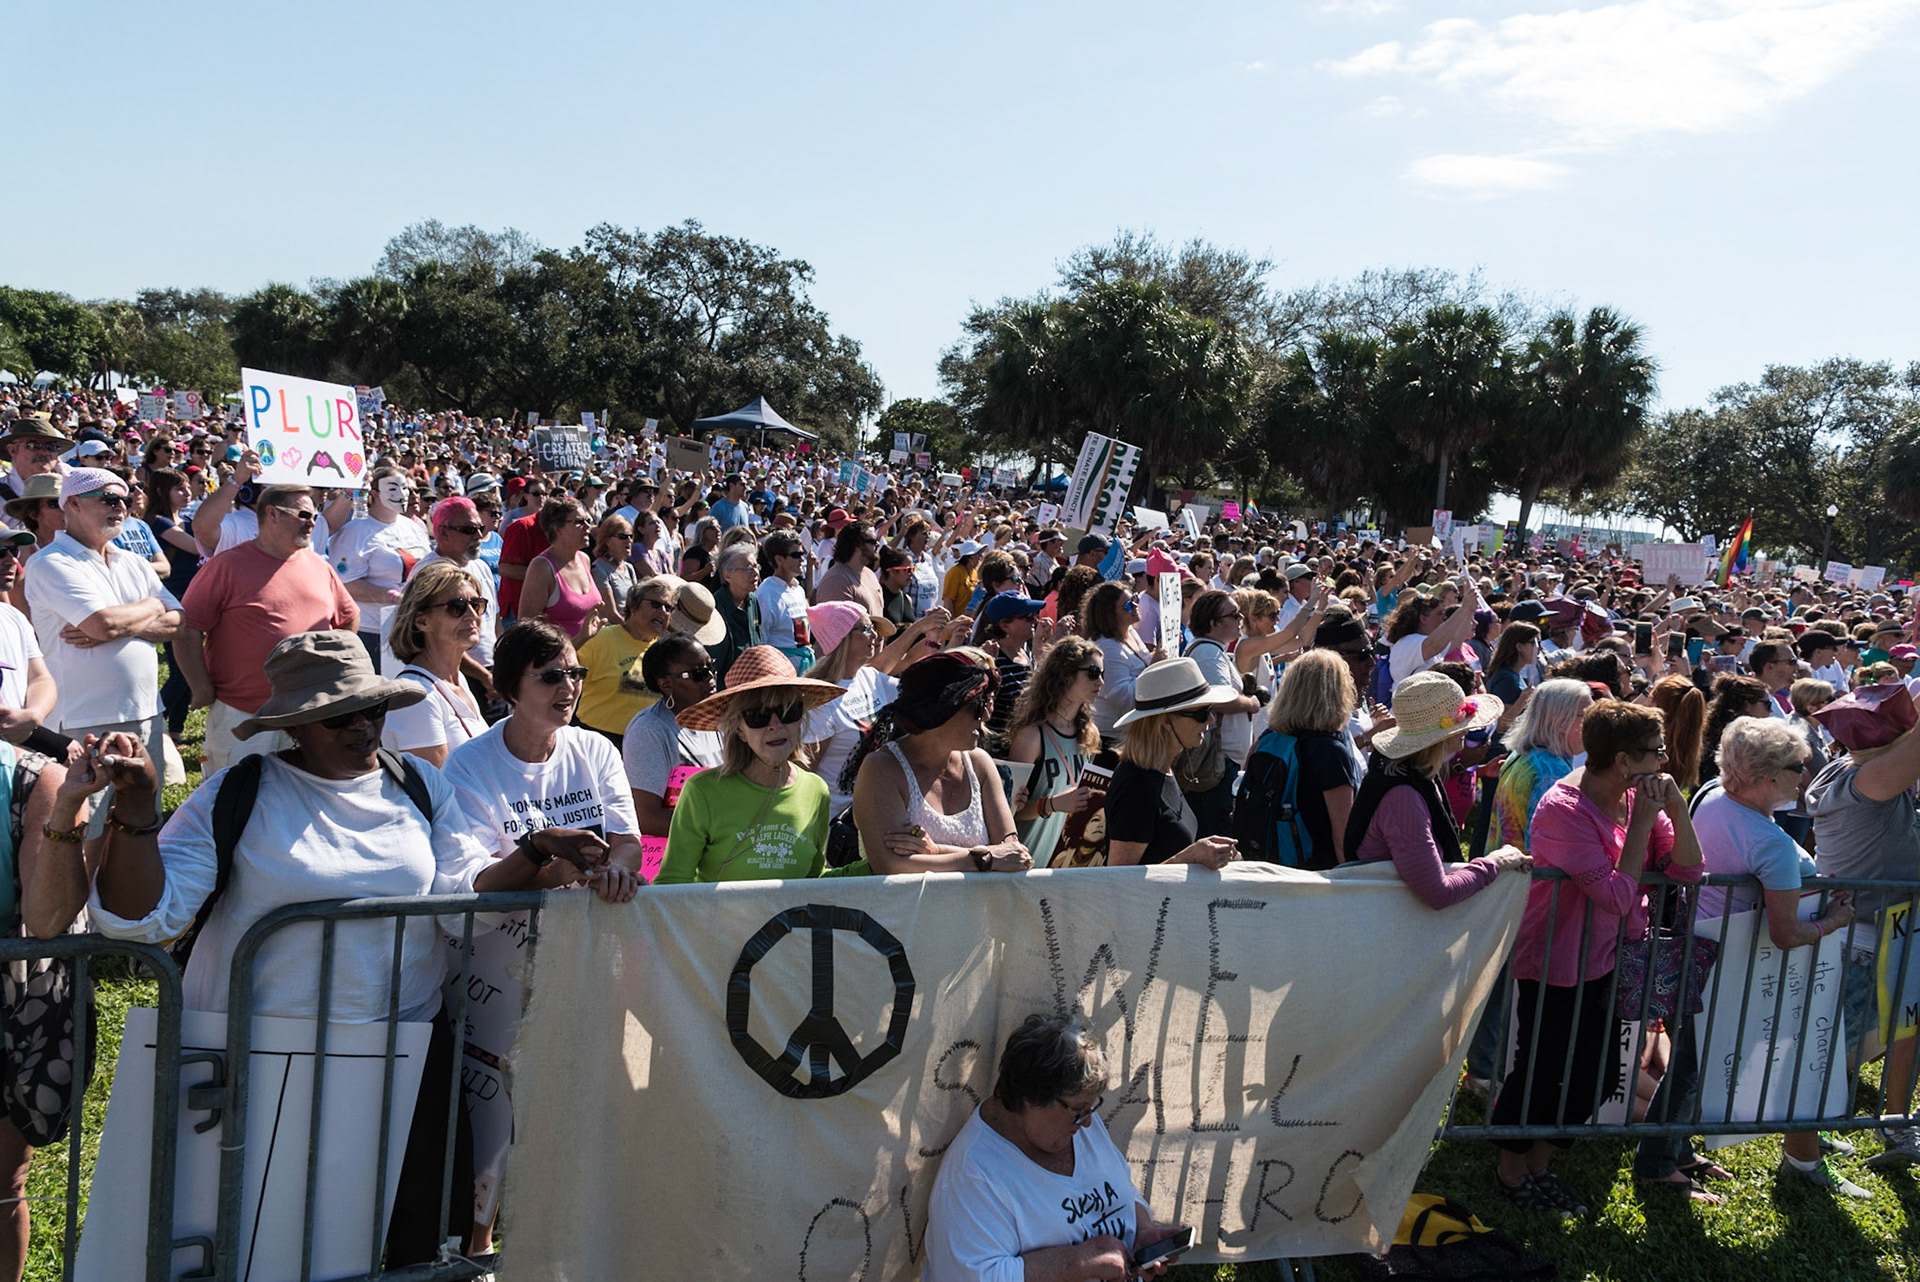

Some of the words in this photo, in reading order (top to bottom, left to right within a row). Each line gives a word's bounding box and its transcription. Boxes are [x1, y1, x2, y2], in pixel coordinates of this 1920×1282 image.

[249, 385, 360, 441] PLUR
[359, 396, 379, 404] SAVE
[551, 433, 564, 441] WE
[565, 433, 579, 442] ARE
[543, 441, 592, 461] CREATED
[554, 455, 586, 468] EQUAL
[1082, 445, 1096, 479] SENATE
[1069, 478, 1086, 514] DISTRICT
[126, 529, 140, 541] AM
[1045, 753, 1092, 789] PIN
[1083, 772, 1105, 785] WOMEN
[508, 799, 552, 814] WOMEN'S
[553, 788, 593, 809] MARCH
[503, 820, 526, 833] FOR
[526, 816, 560, 832] SOCIAL
[562, 804, 604, 826] JUSTICE
[750, 832, 772, 844] RALPH
[773, 832, 797, 845] LAUREN
[1760, 945, 1775, 962] in
[1040, 895, 1268, 1043] WE
[1787, 963, 1804, 999] wish
[1814, 960, 1835, 996] the
[1761, 973, 1779, 998] the
[1791, 1005, 1803, 1020] to
[918, 1038, 1342, 1159] SALL
[1104, 1181, 1119, 1207] A
